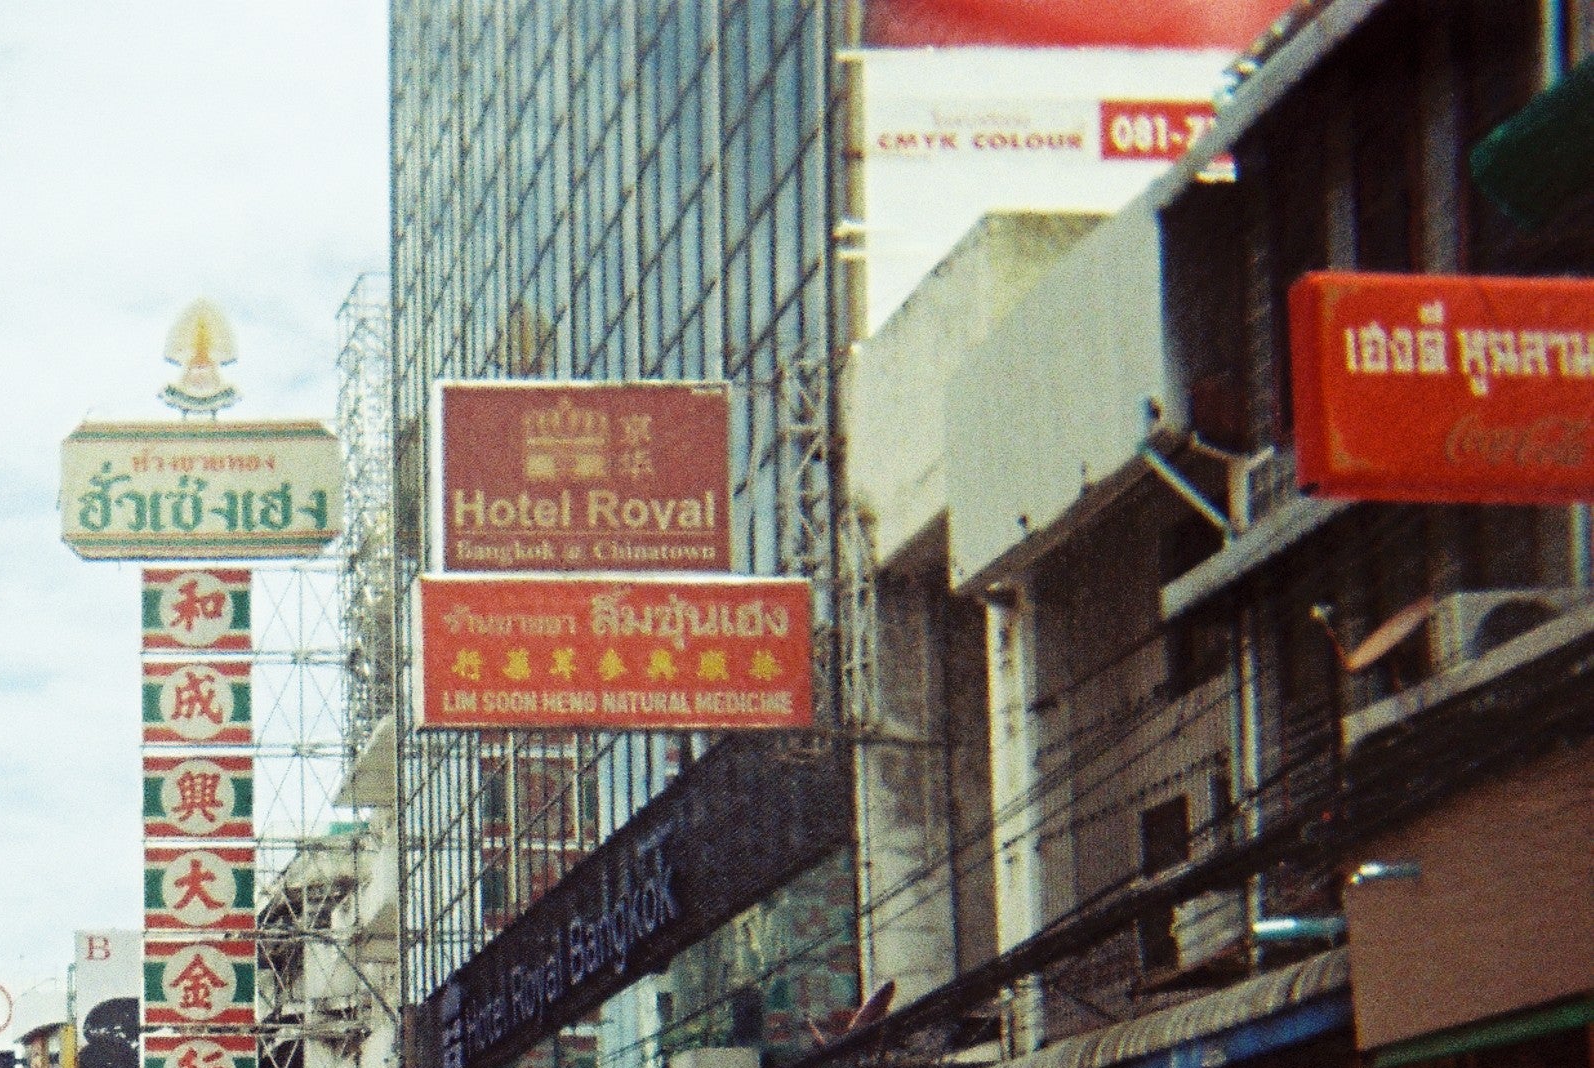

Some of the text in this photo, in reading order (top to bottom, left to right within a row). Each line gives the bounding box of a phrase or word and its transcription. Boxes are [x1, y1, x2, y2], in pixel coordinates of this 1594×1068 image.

[972, 131, 1084, 151] COLOUR
[455, 488, 716, 532] Hotel Royal
[601, 690, 692, 715] NATURAL
